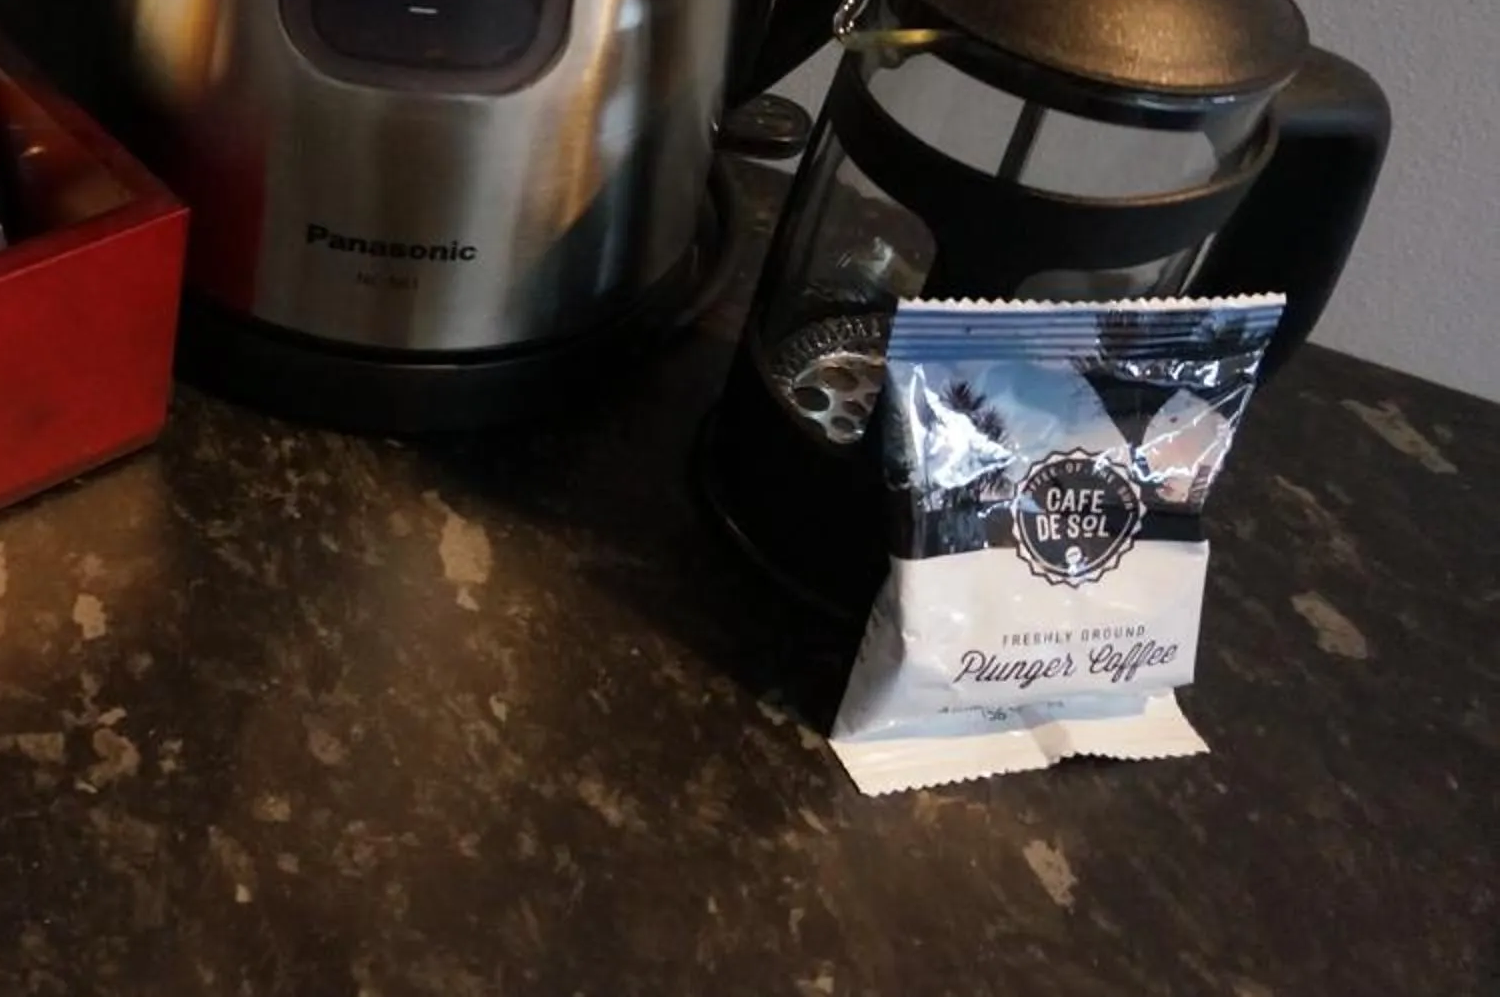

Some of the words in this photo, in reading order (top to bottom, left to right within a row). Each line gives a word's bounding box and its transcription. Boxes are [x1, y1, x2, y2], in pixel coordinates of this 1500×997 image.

[305, 222, 477, 262] Panasonic
[1046, 487, 1105, 513] CAFE
[1036, 514, 1062, 542] DE
[1066, 513, 1109, 539] SOL
[1002, 631, 1073, 648] FRESHLY
[1080, 624, 1146, 643] GROUND
[952, 649, 1077, 689] Plunger
[1088, 639, 1179, 684] Coffee
